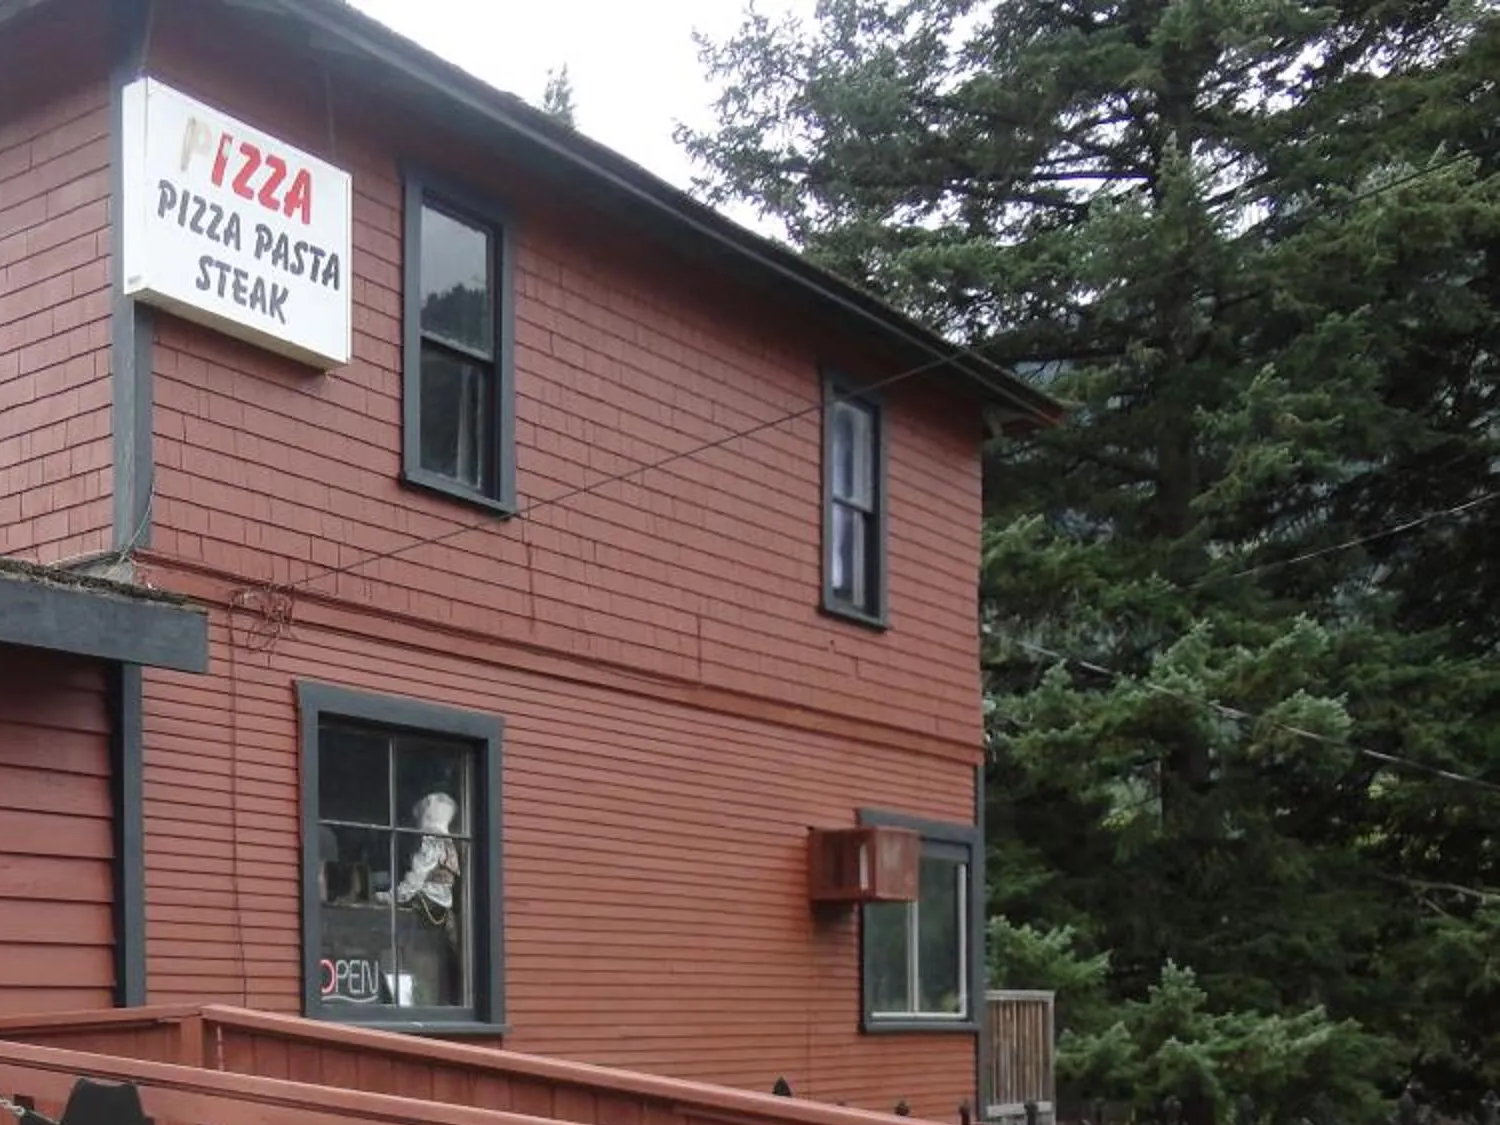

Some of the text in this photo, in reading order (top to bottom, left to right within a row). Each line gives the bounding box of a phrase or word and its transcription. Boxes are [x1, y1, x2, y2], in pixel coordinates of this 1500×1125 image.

[177, 115, 314, 225] PIZZA
[157, 179, 341, 290] PIZZA PASTA
[196, 255, 289, 324] STEAK
